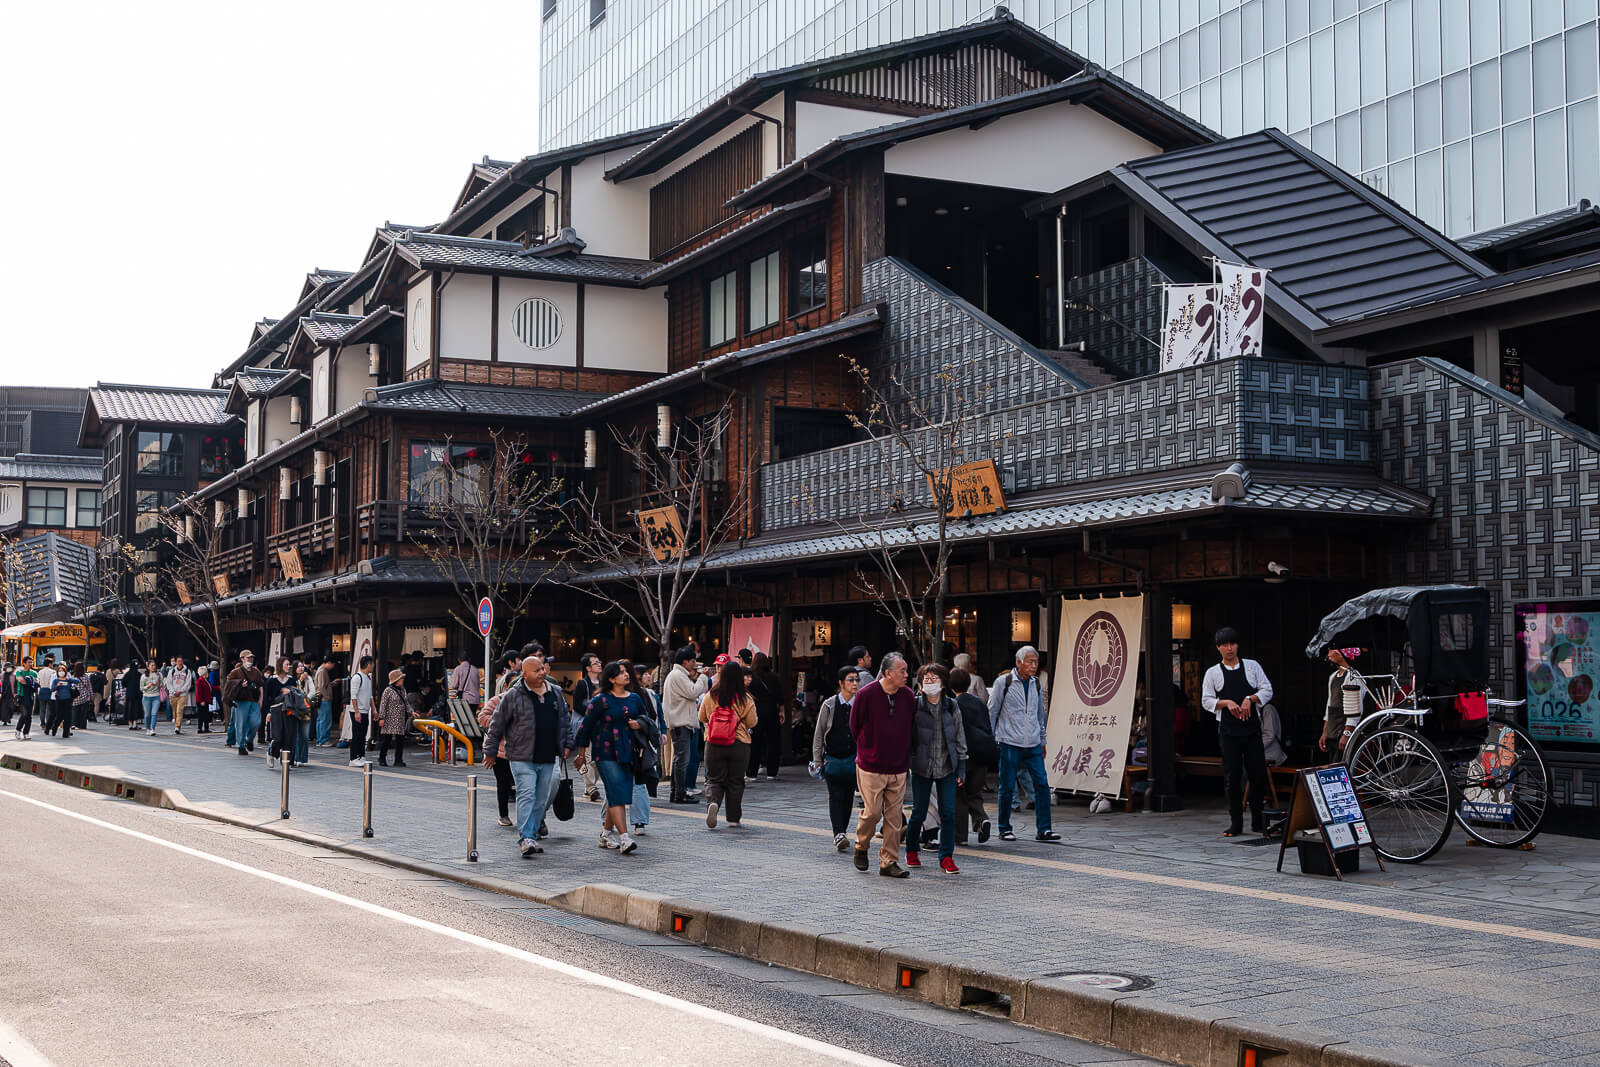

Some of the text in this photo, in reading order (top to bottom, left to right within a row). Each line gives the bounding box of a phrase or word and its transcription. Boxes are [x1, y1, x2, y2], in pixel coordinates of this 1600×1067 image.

[50, 628, 83, 637] SCHOOL BUS
[1052, 745, 1116, 779] 相模屋
